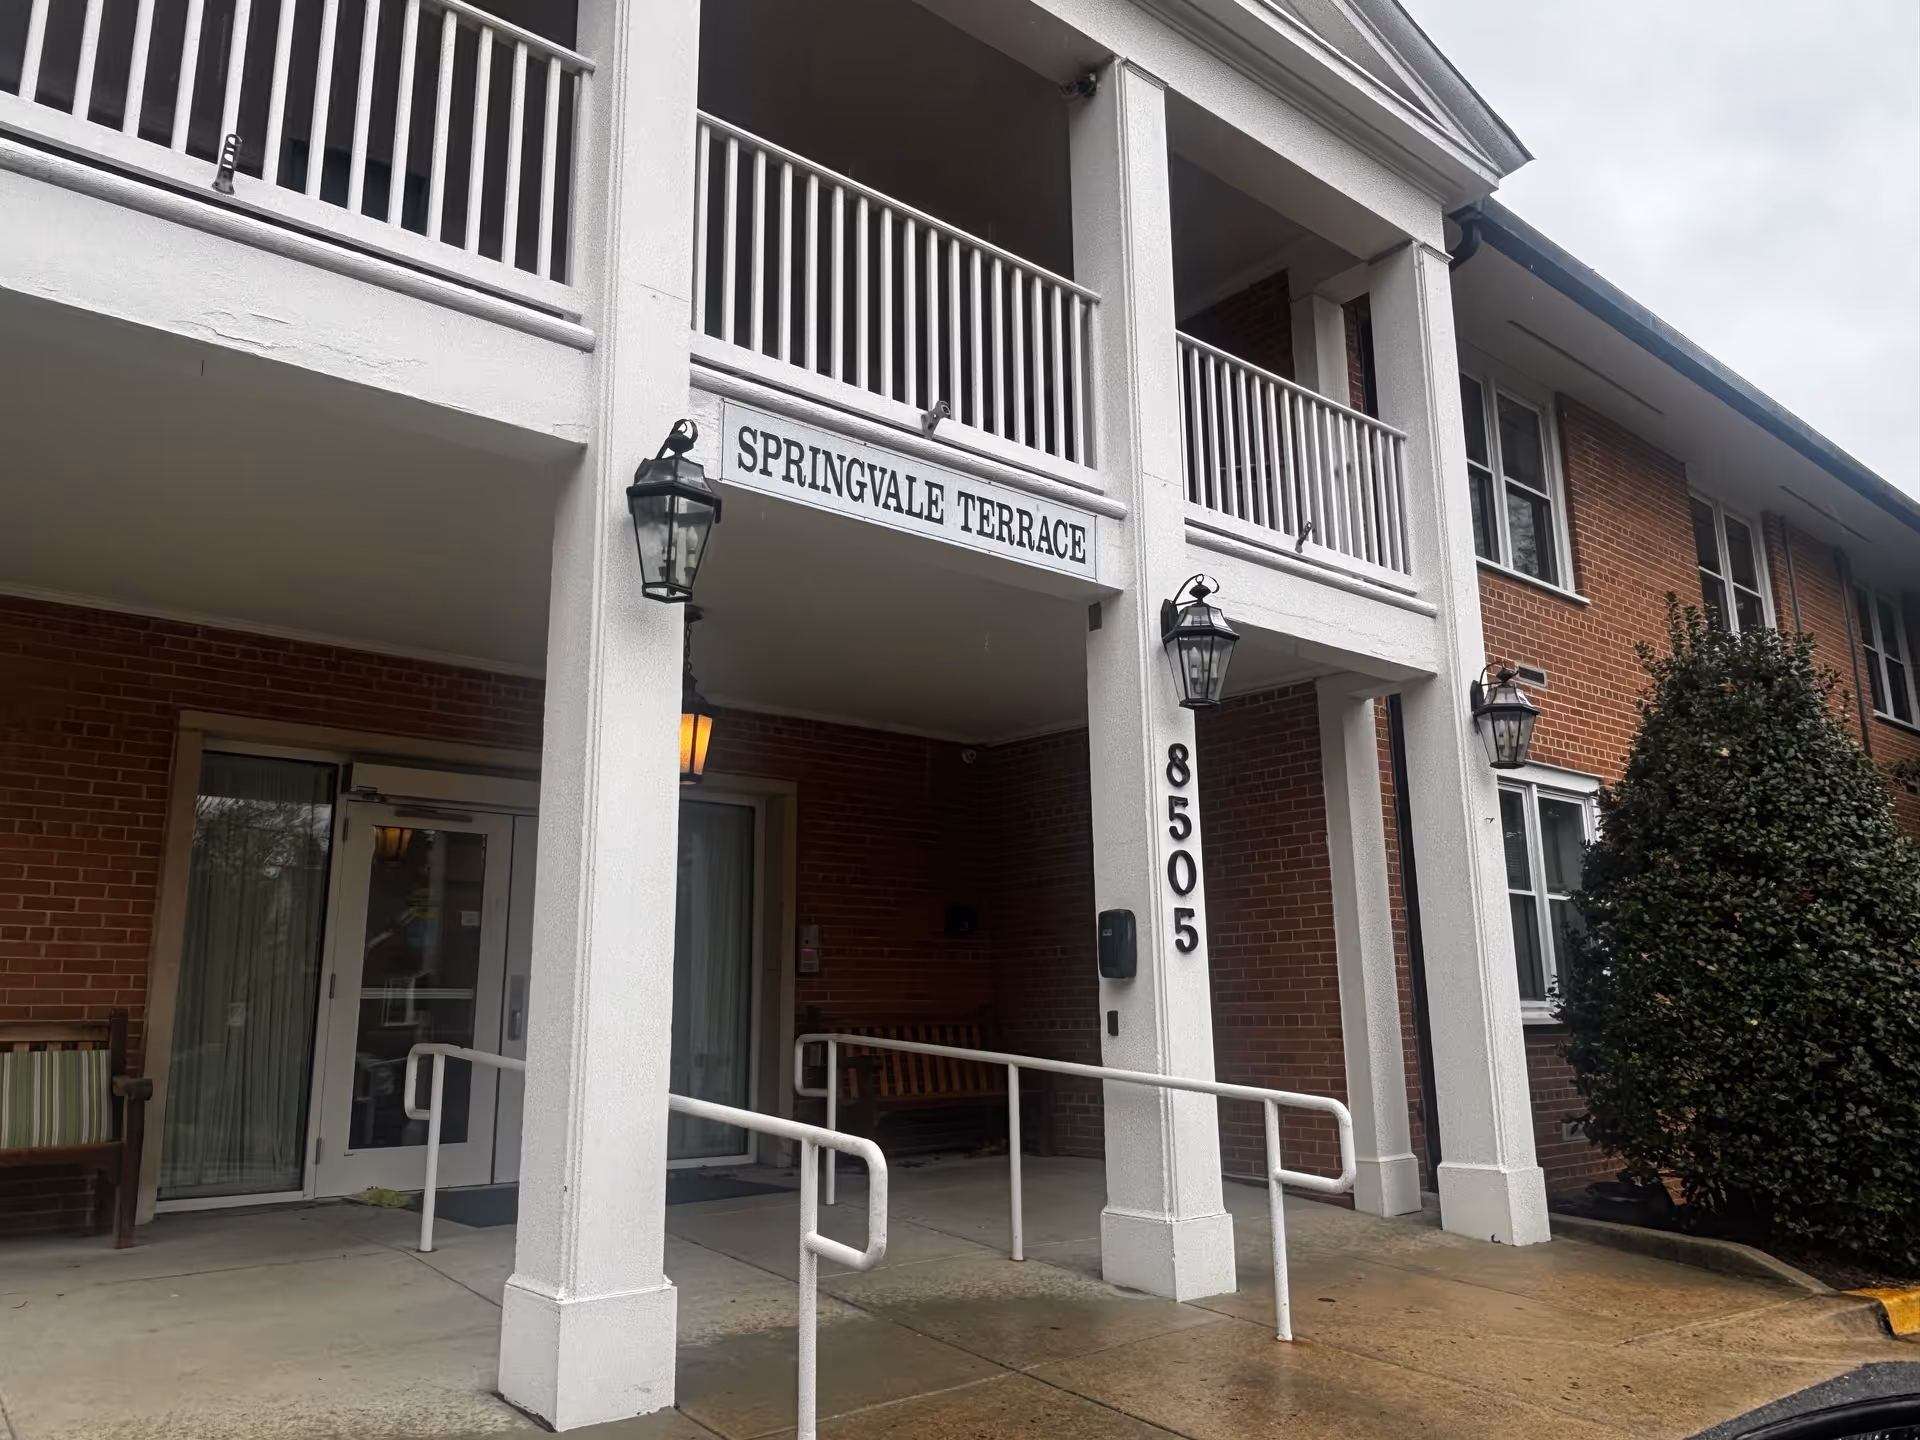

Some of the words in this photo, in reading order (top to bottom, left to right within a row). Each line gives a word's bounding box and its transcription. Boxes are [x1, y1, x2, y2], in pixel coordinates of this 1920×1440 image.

[737, 425, 945, 525] SPRINGVALE
[956, 490, 1087, 565] TERRACE
[1165, 742, 1199, 953] 8505
